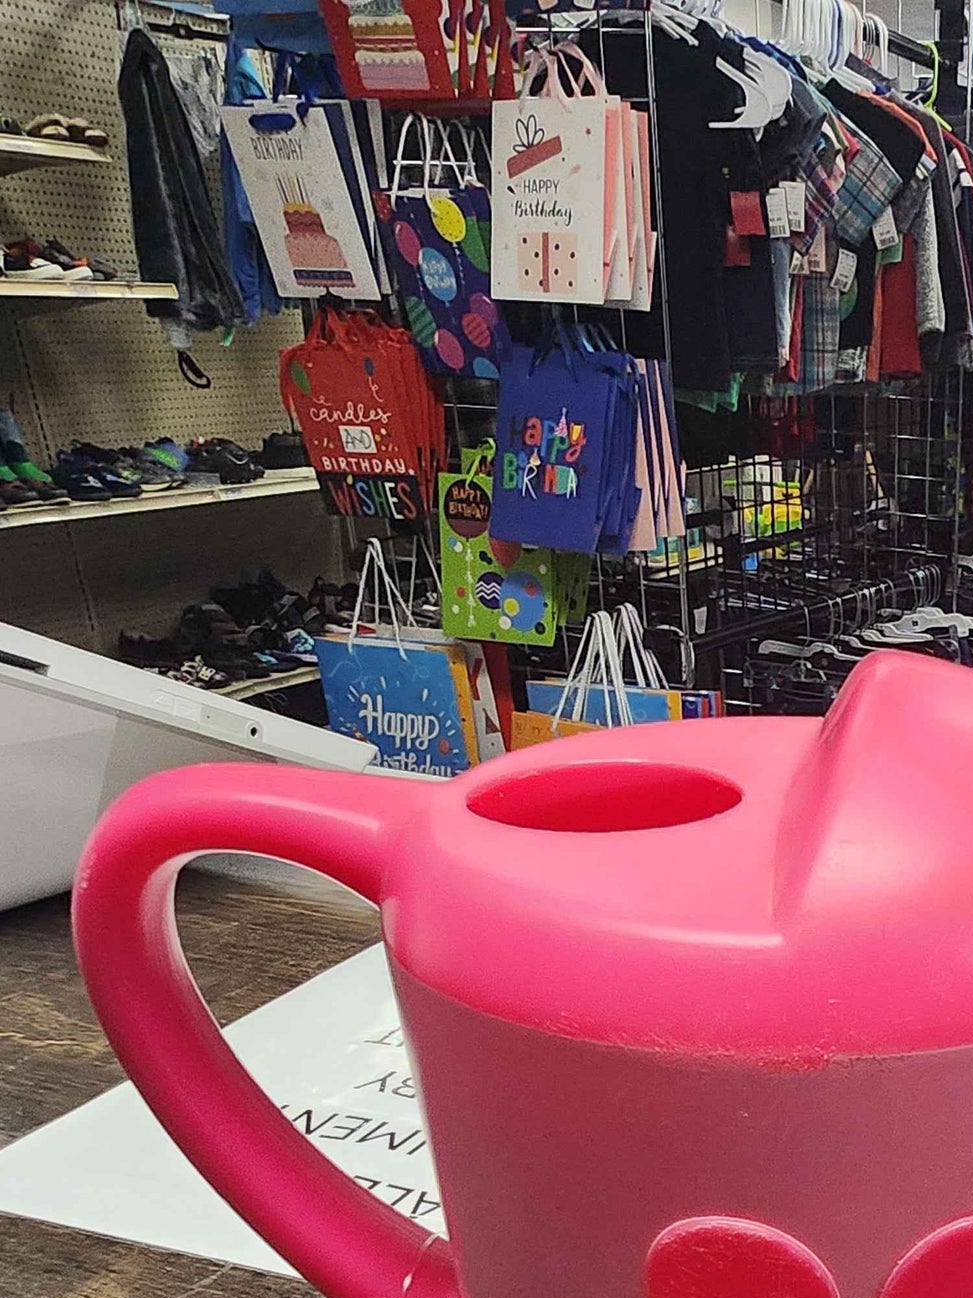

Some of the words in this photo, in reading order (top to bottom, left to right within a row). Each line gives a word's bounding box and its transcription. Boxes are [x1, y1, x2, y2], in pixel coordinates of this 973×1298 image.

[250, 137, 304, 160] BIRTHDAY
[523, 179, 560, 194] HAPPY
[514, 198, 572, 227] Birthday
[310, 401, 392, 424] candles
[344, 428, 373, 450] AND
[358, 693, 440, 750] Happy
